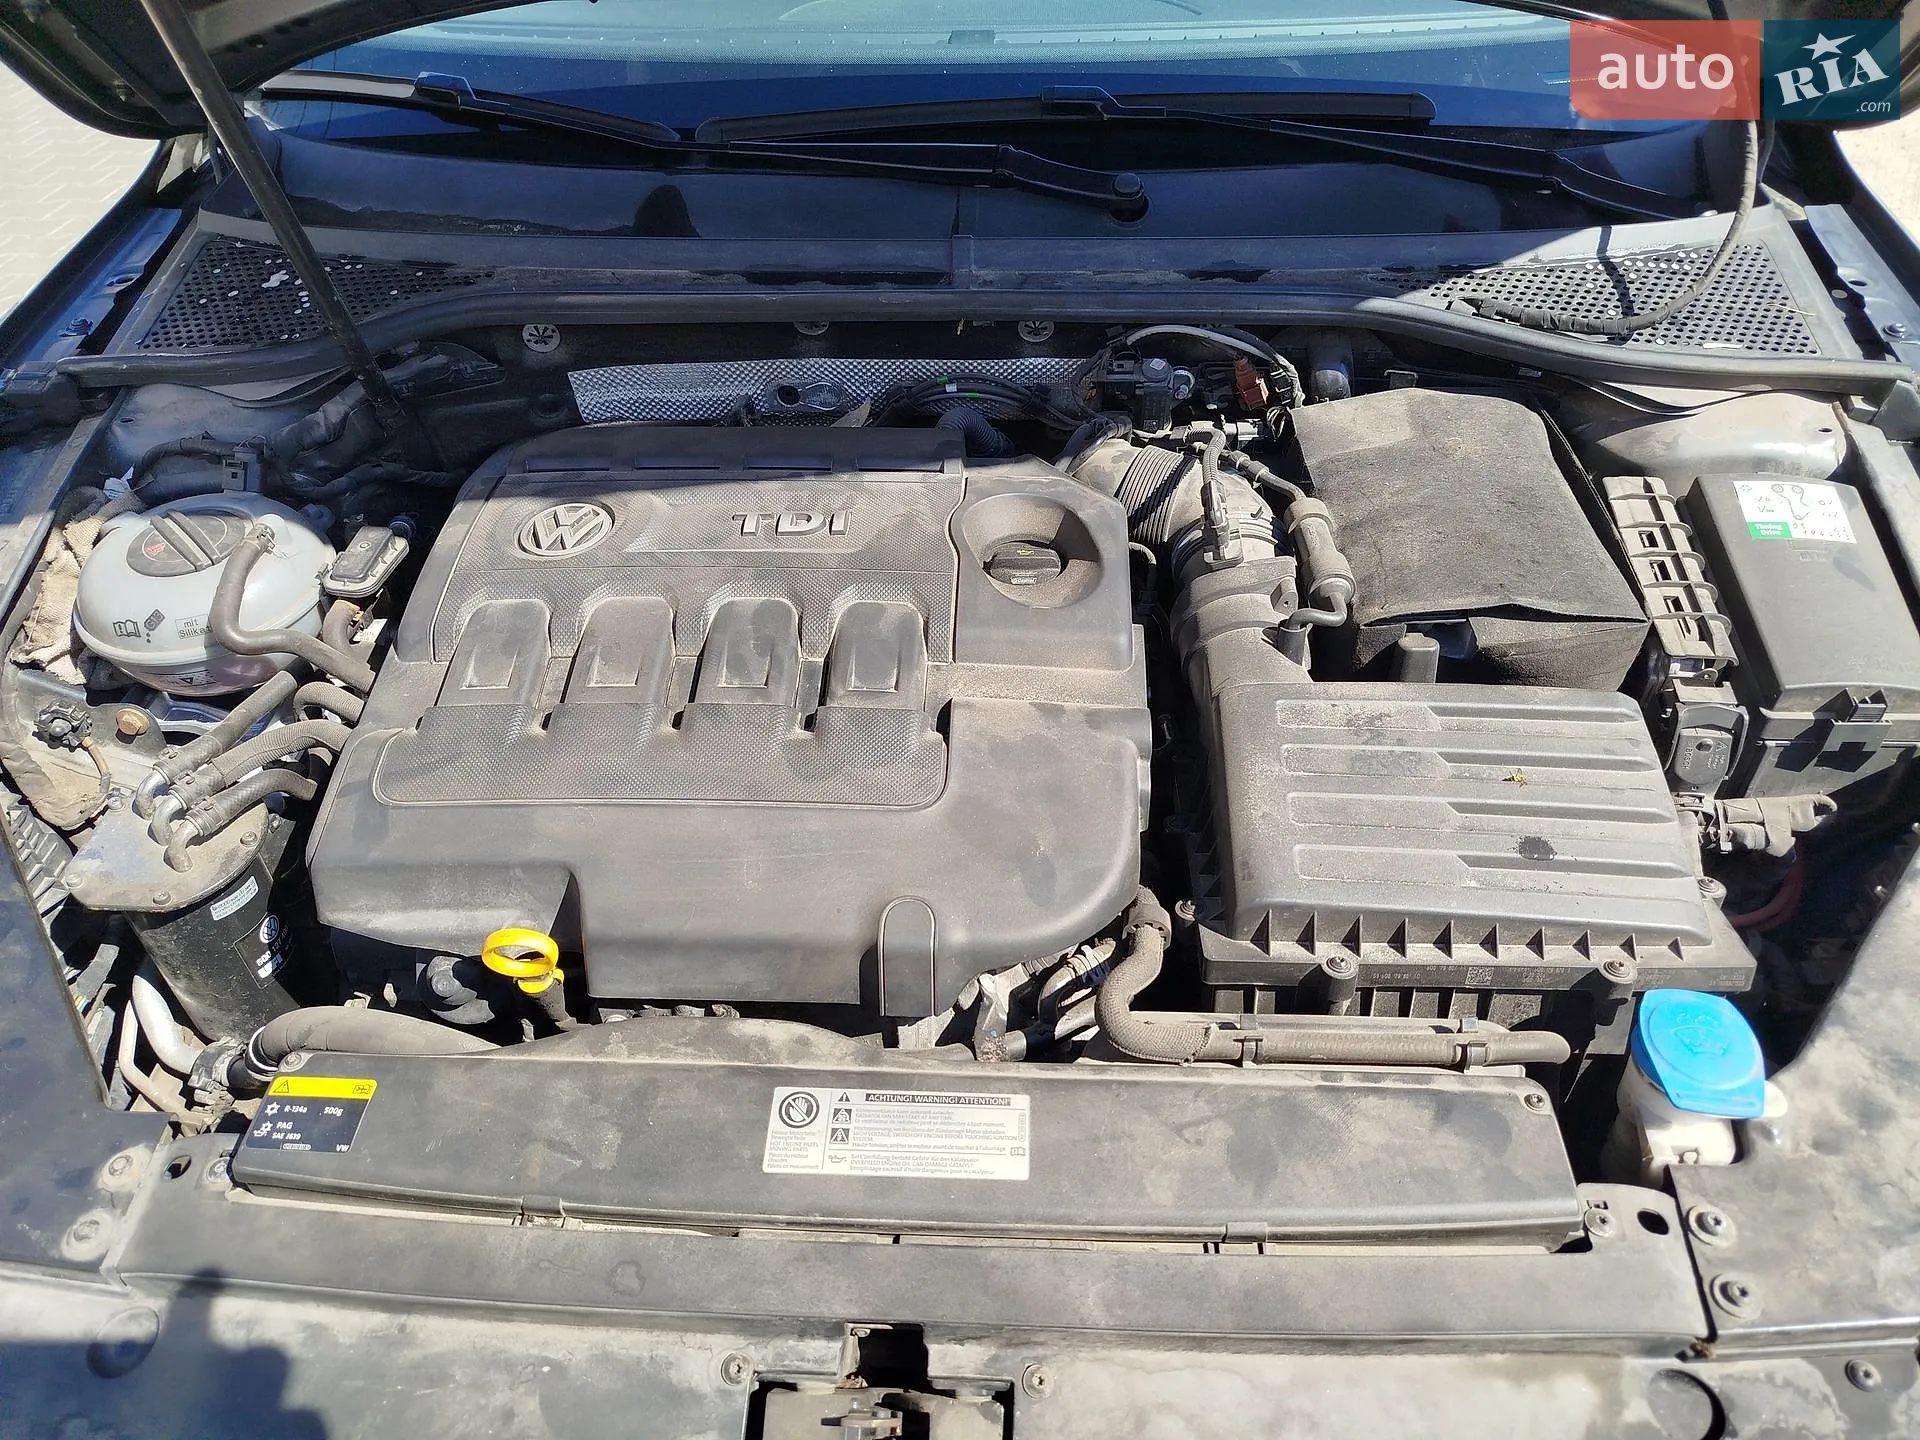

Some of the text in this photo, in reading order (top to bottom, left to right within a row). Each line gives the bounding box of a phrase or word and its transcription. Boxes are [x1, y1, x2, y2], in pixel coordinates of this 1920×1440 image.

[732, 510, 850, 537] TDI
[183, 618, 199, 629] mit
[1682, 746, 1694, 769] BOSCH
[868, 1094, 1009, 1105] ACHTUNG! WARNING! ATTENTION!
[284, 1105, 344, 1117] R-134a 500g
[276, 1121, 293, 1130] PAG
[271, 1132, 301, 1140] SAE J639
[336, 1144, 350, 1152] VW
